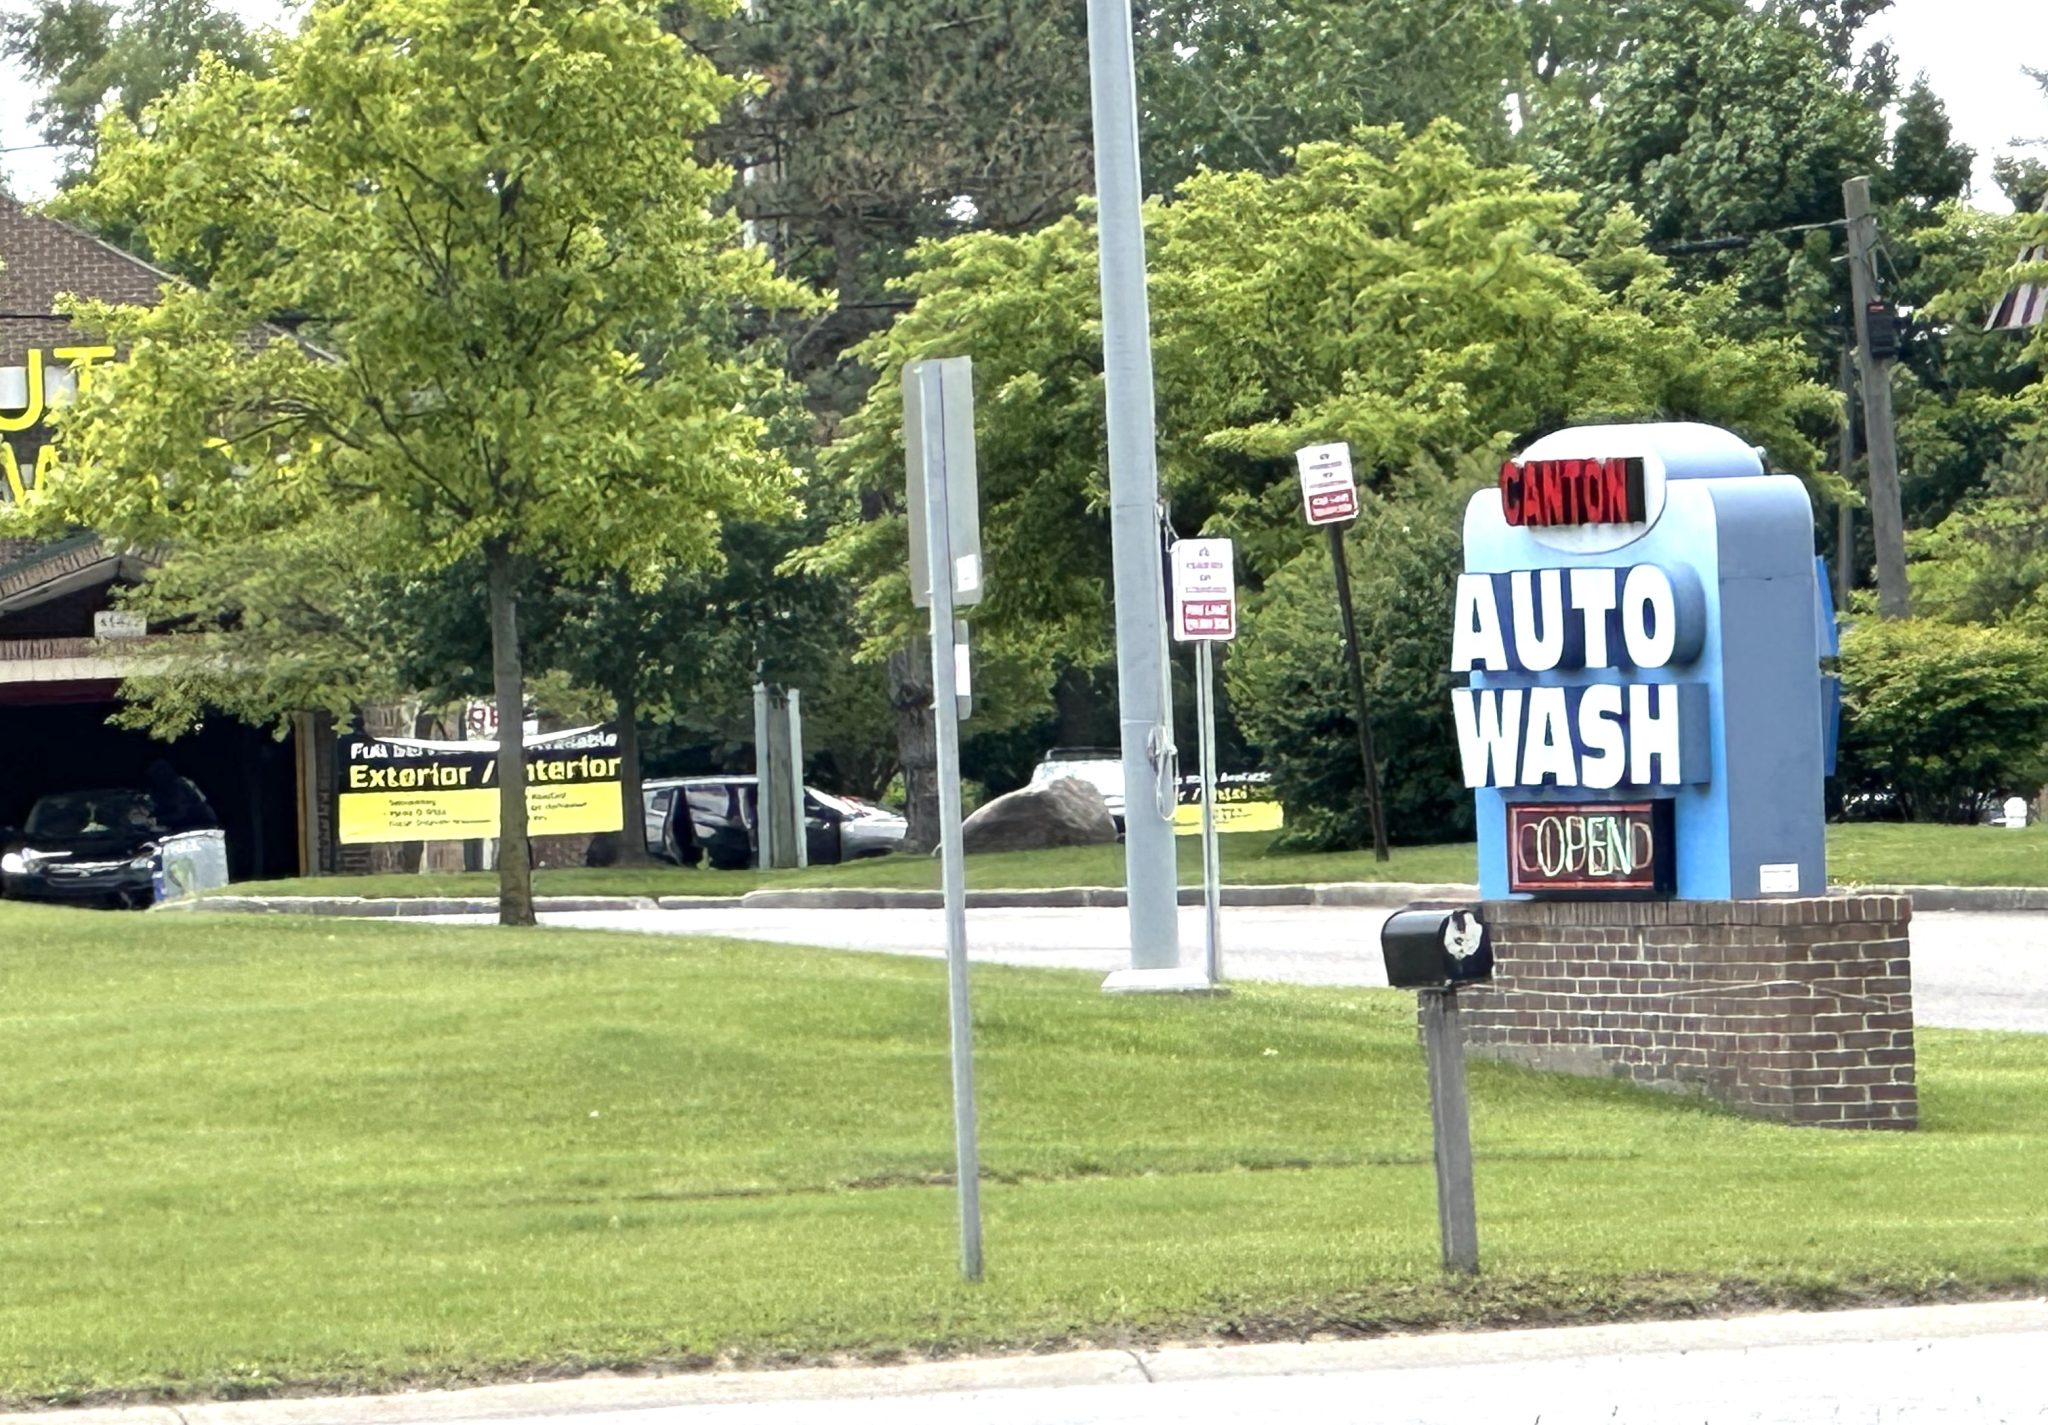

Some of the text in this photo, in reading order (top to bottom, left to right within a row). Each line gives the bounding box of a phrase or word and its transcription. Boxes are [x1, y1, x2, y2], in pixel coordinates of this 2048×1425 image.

[1501, 458, 1630, 527] CANTON
[1451, 564, 1676, 672] AUTO
[349, 762, 472, 788] Exterior
[525, 754, 622, 782] nterior
[1451, 684, 1681, 790] WASH
[1537, 815, 1632, 877] OPEN
